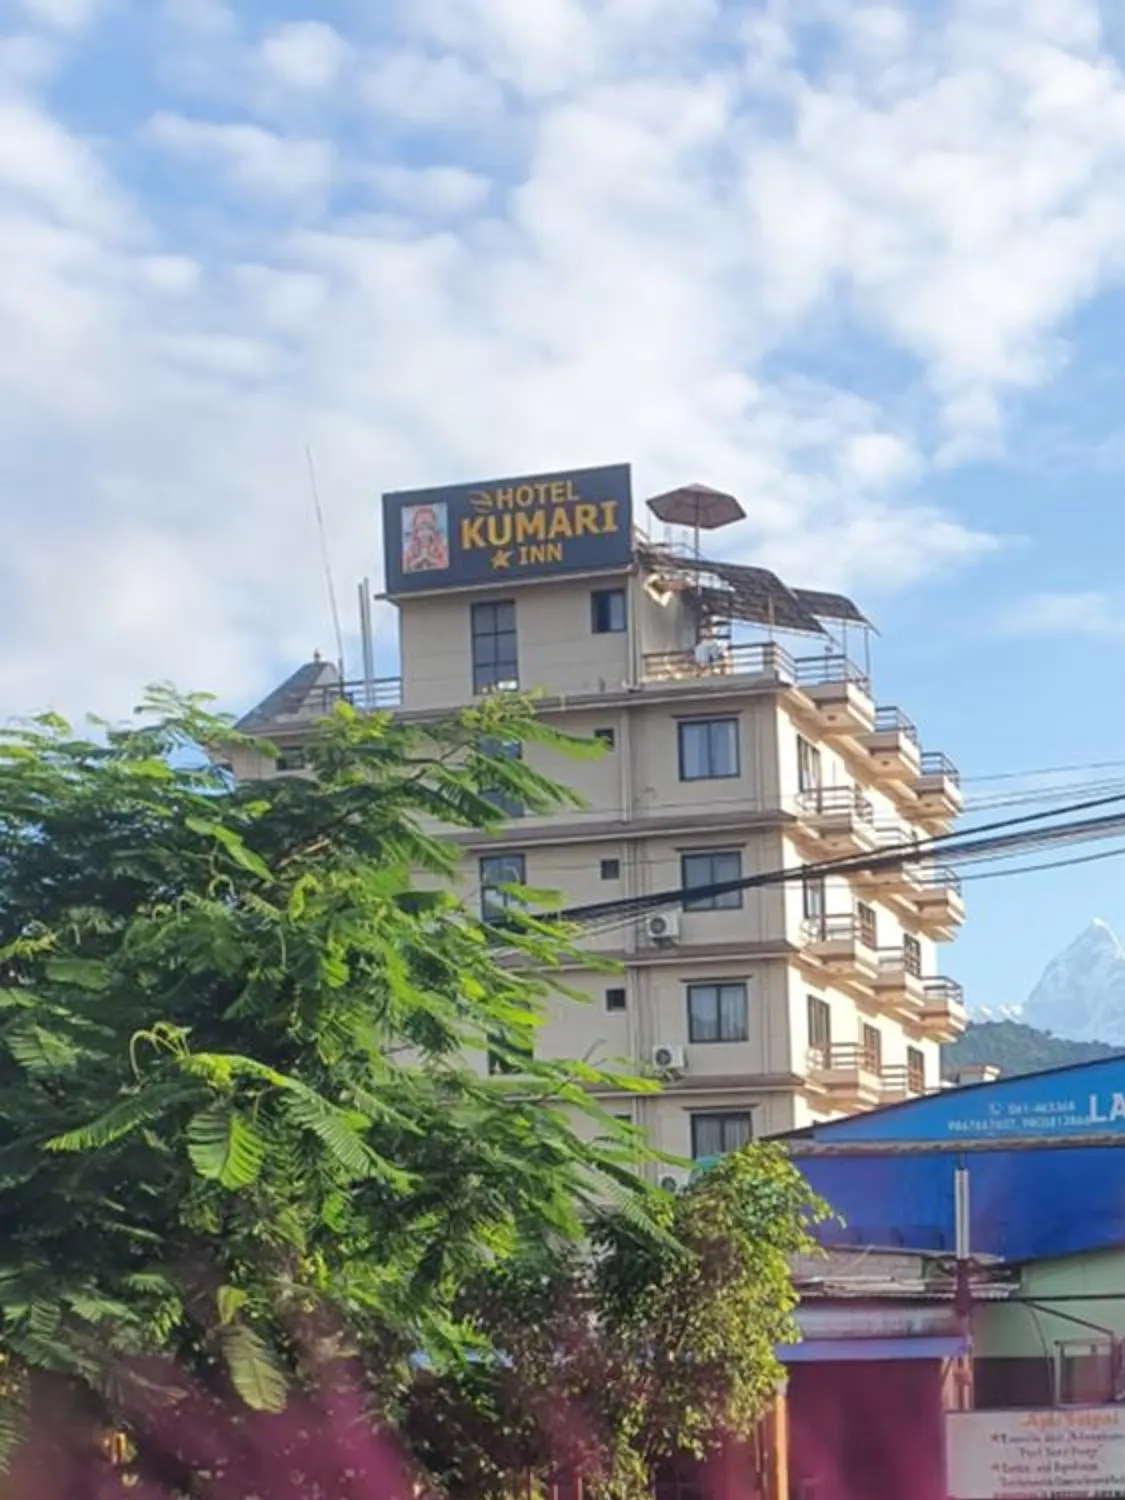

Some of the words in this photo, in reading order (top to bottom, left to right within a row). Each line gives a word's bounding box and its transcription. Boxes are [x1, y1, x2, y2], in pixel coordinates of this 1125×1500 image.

[496, 479, 580, 510] HOTEL
[460, 500, 619, 550] KUMARI
[519, 542, 564, 566] INN
